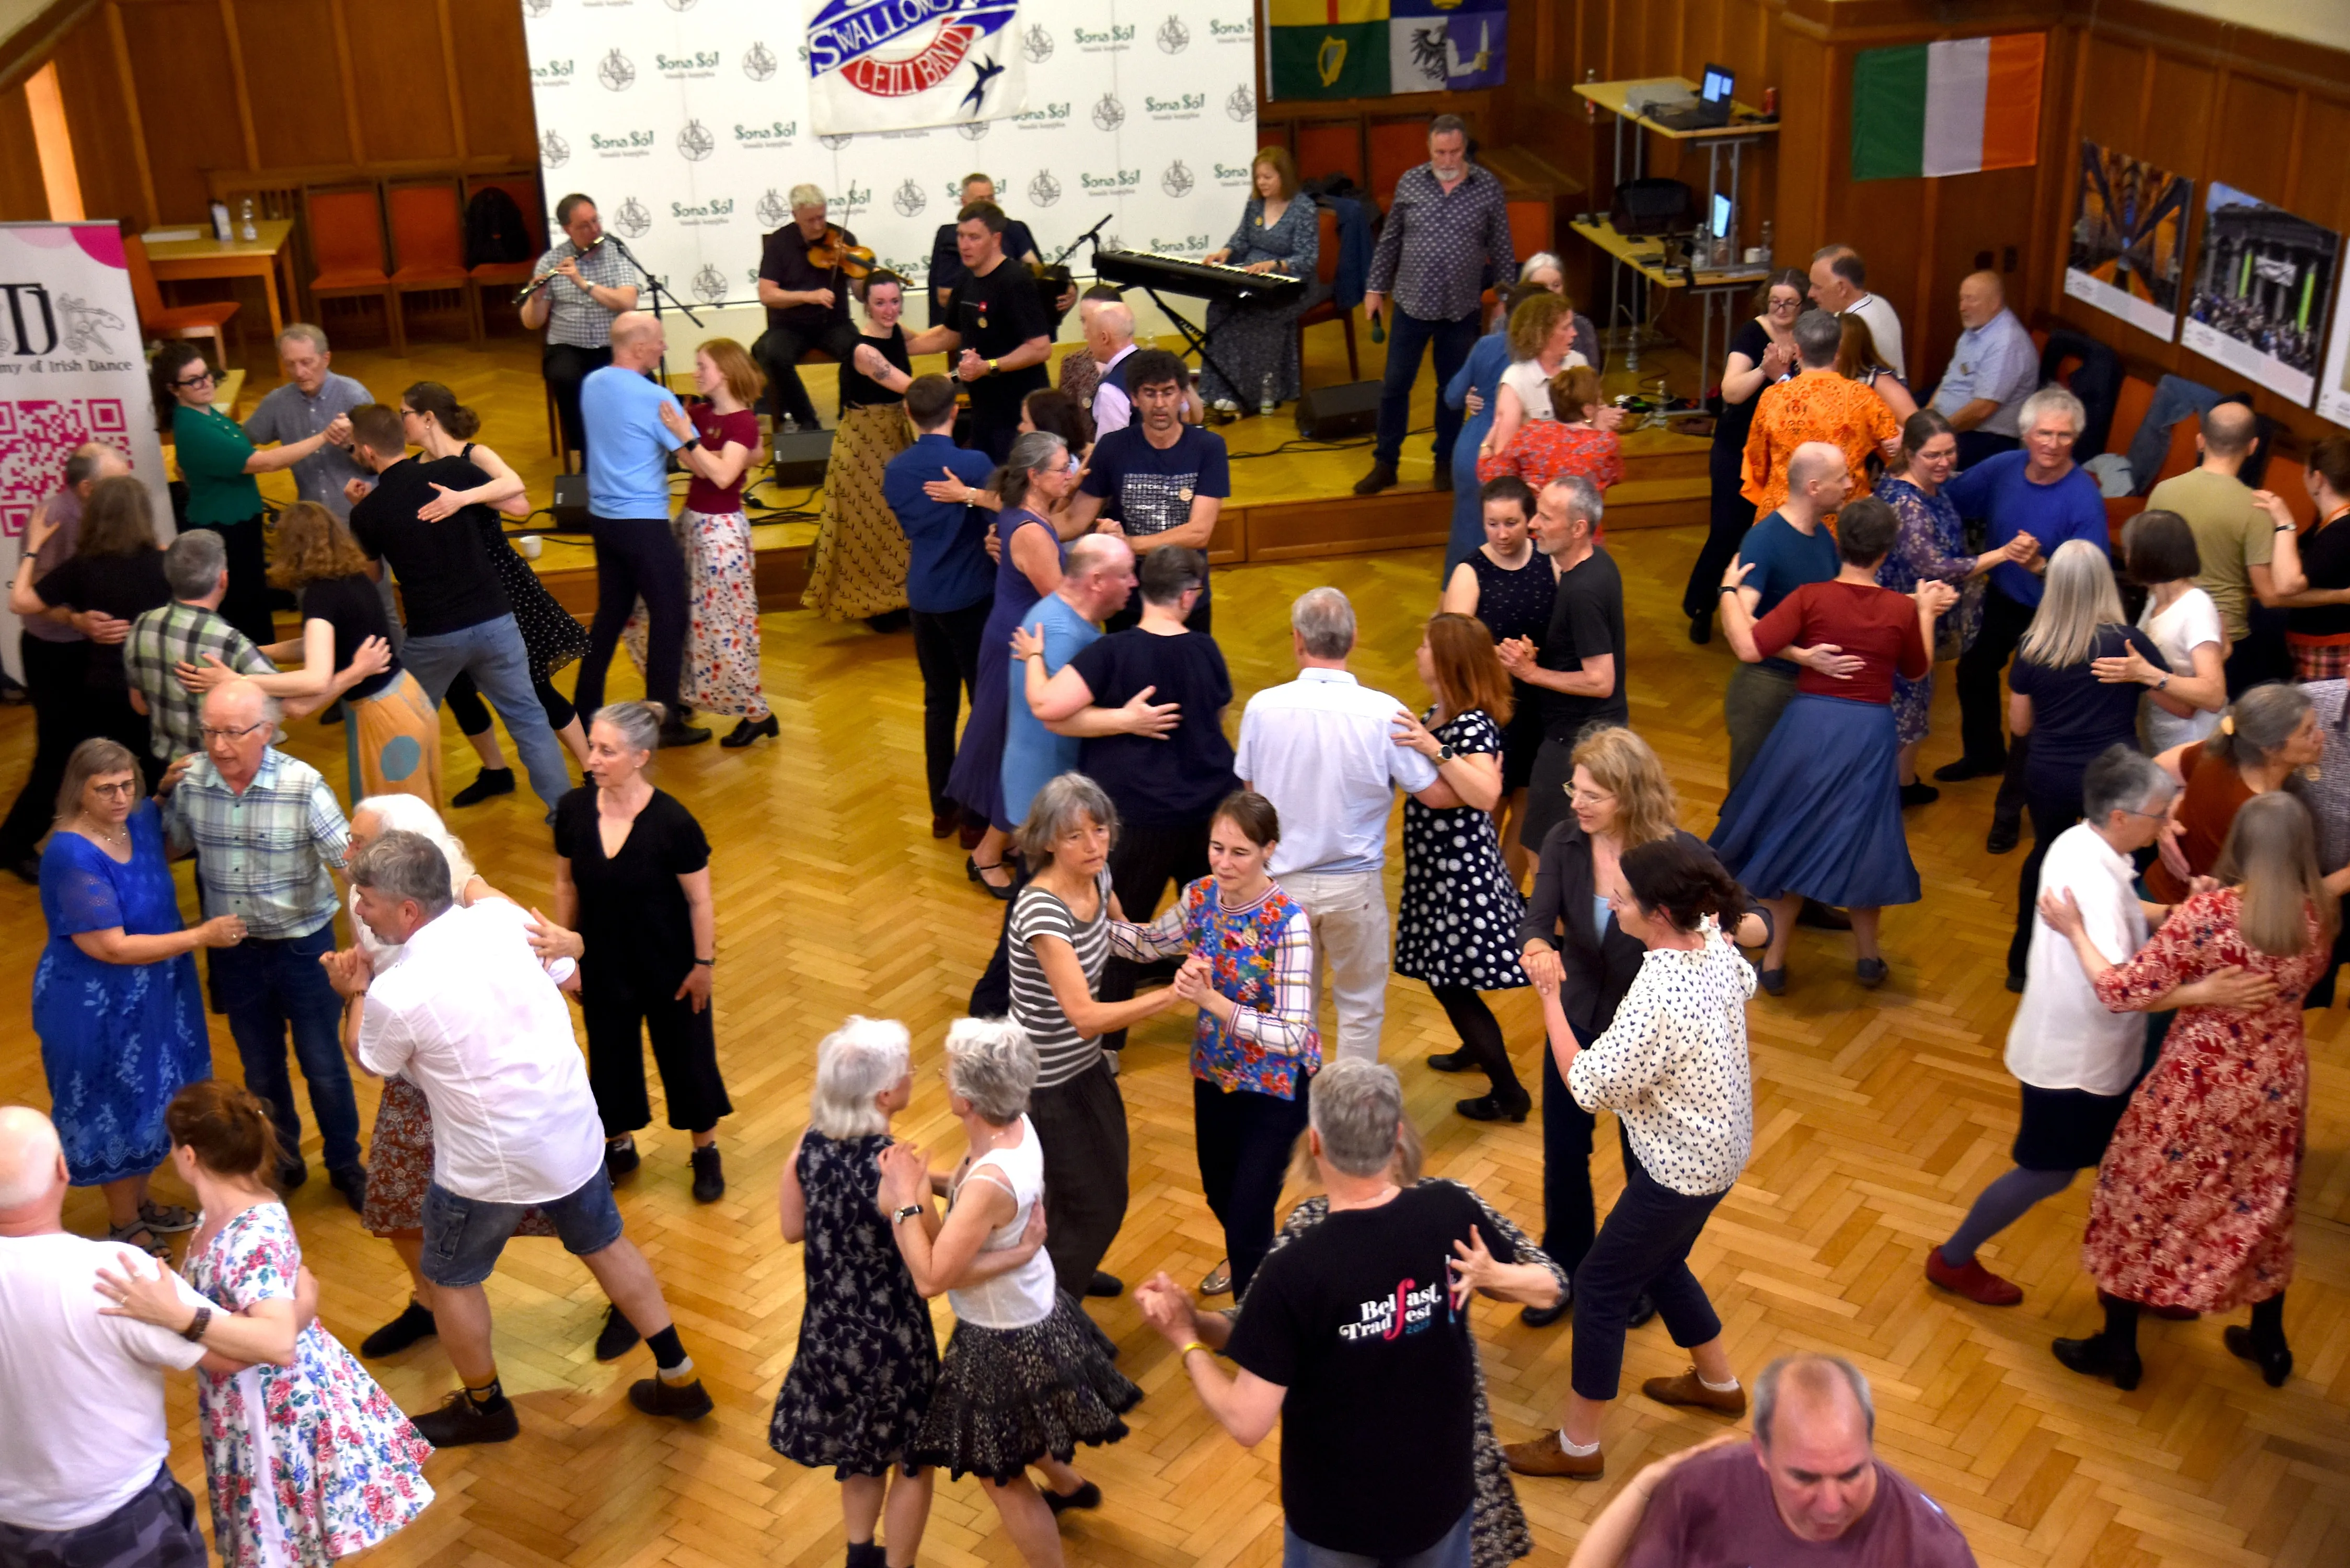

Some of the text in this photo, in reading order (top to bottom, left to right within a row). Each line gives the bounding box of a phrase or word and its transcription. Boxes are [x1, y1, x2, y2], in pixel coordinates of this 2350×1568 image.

[1074, 28, 1109, 44] Sona
[656, 54, 694, 70] Sona
[916, 29, 969, 87] BAND
[1145, 97, 1179, 112] Sona
[734, 124, 770, 141] Sona
[591, 134, 628, 149] Sona
[1081, 173, 1115, 188] Sona
[672, 202, 708, 217] Sona
[49, 360, 83, 373] Irish
[87, 360, 132, 372] Dance
